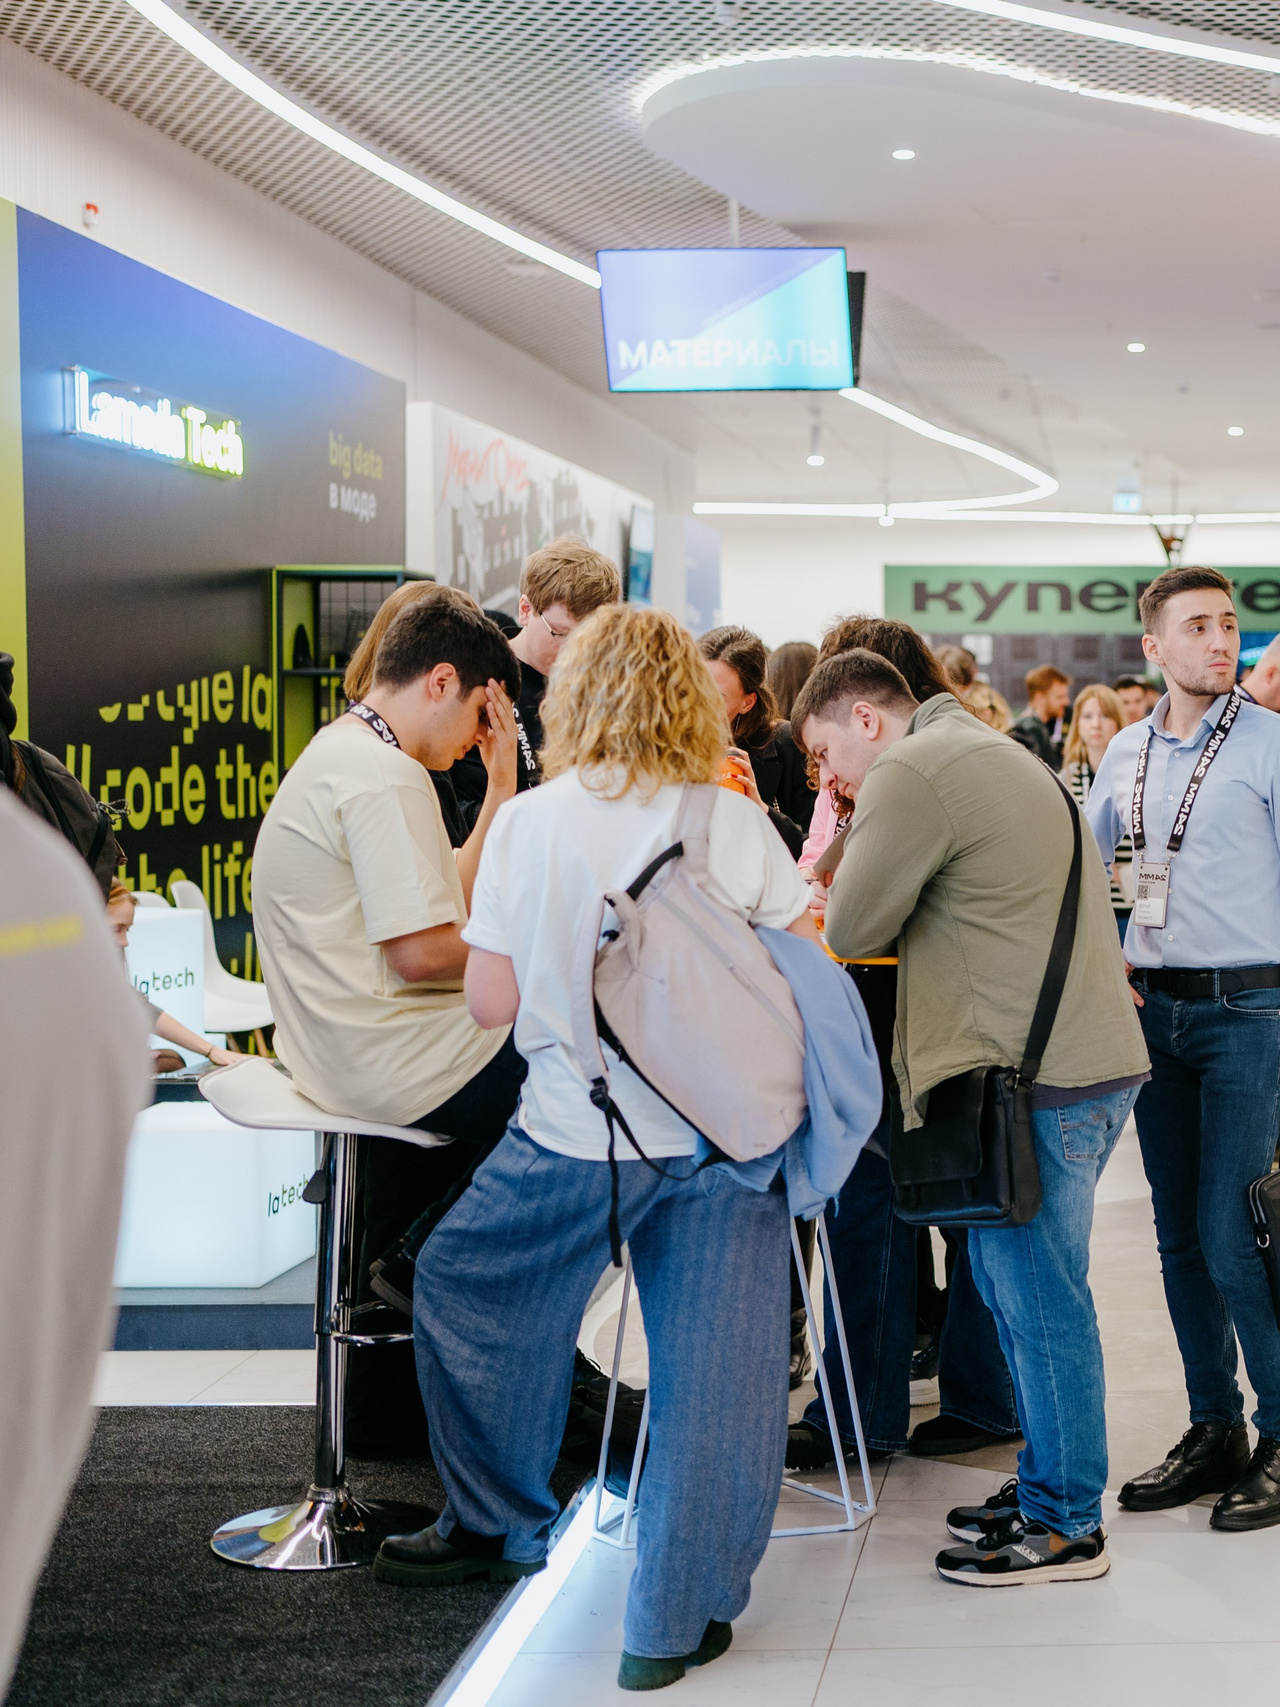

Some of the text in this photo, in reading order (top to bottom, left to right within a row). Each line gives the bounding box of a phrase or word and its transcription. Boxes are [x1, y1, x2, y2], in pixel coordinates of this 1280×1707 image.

[617, 338, 840, 370] МАТЕРИАЛЫ
[183, 405, 244, 476] Tech
[328, 429, 384, 480] big data
